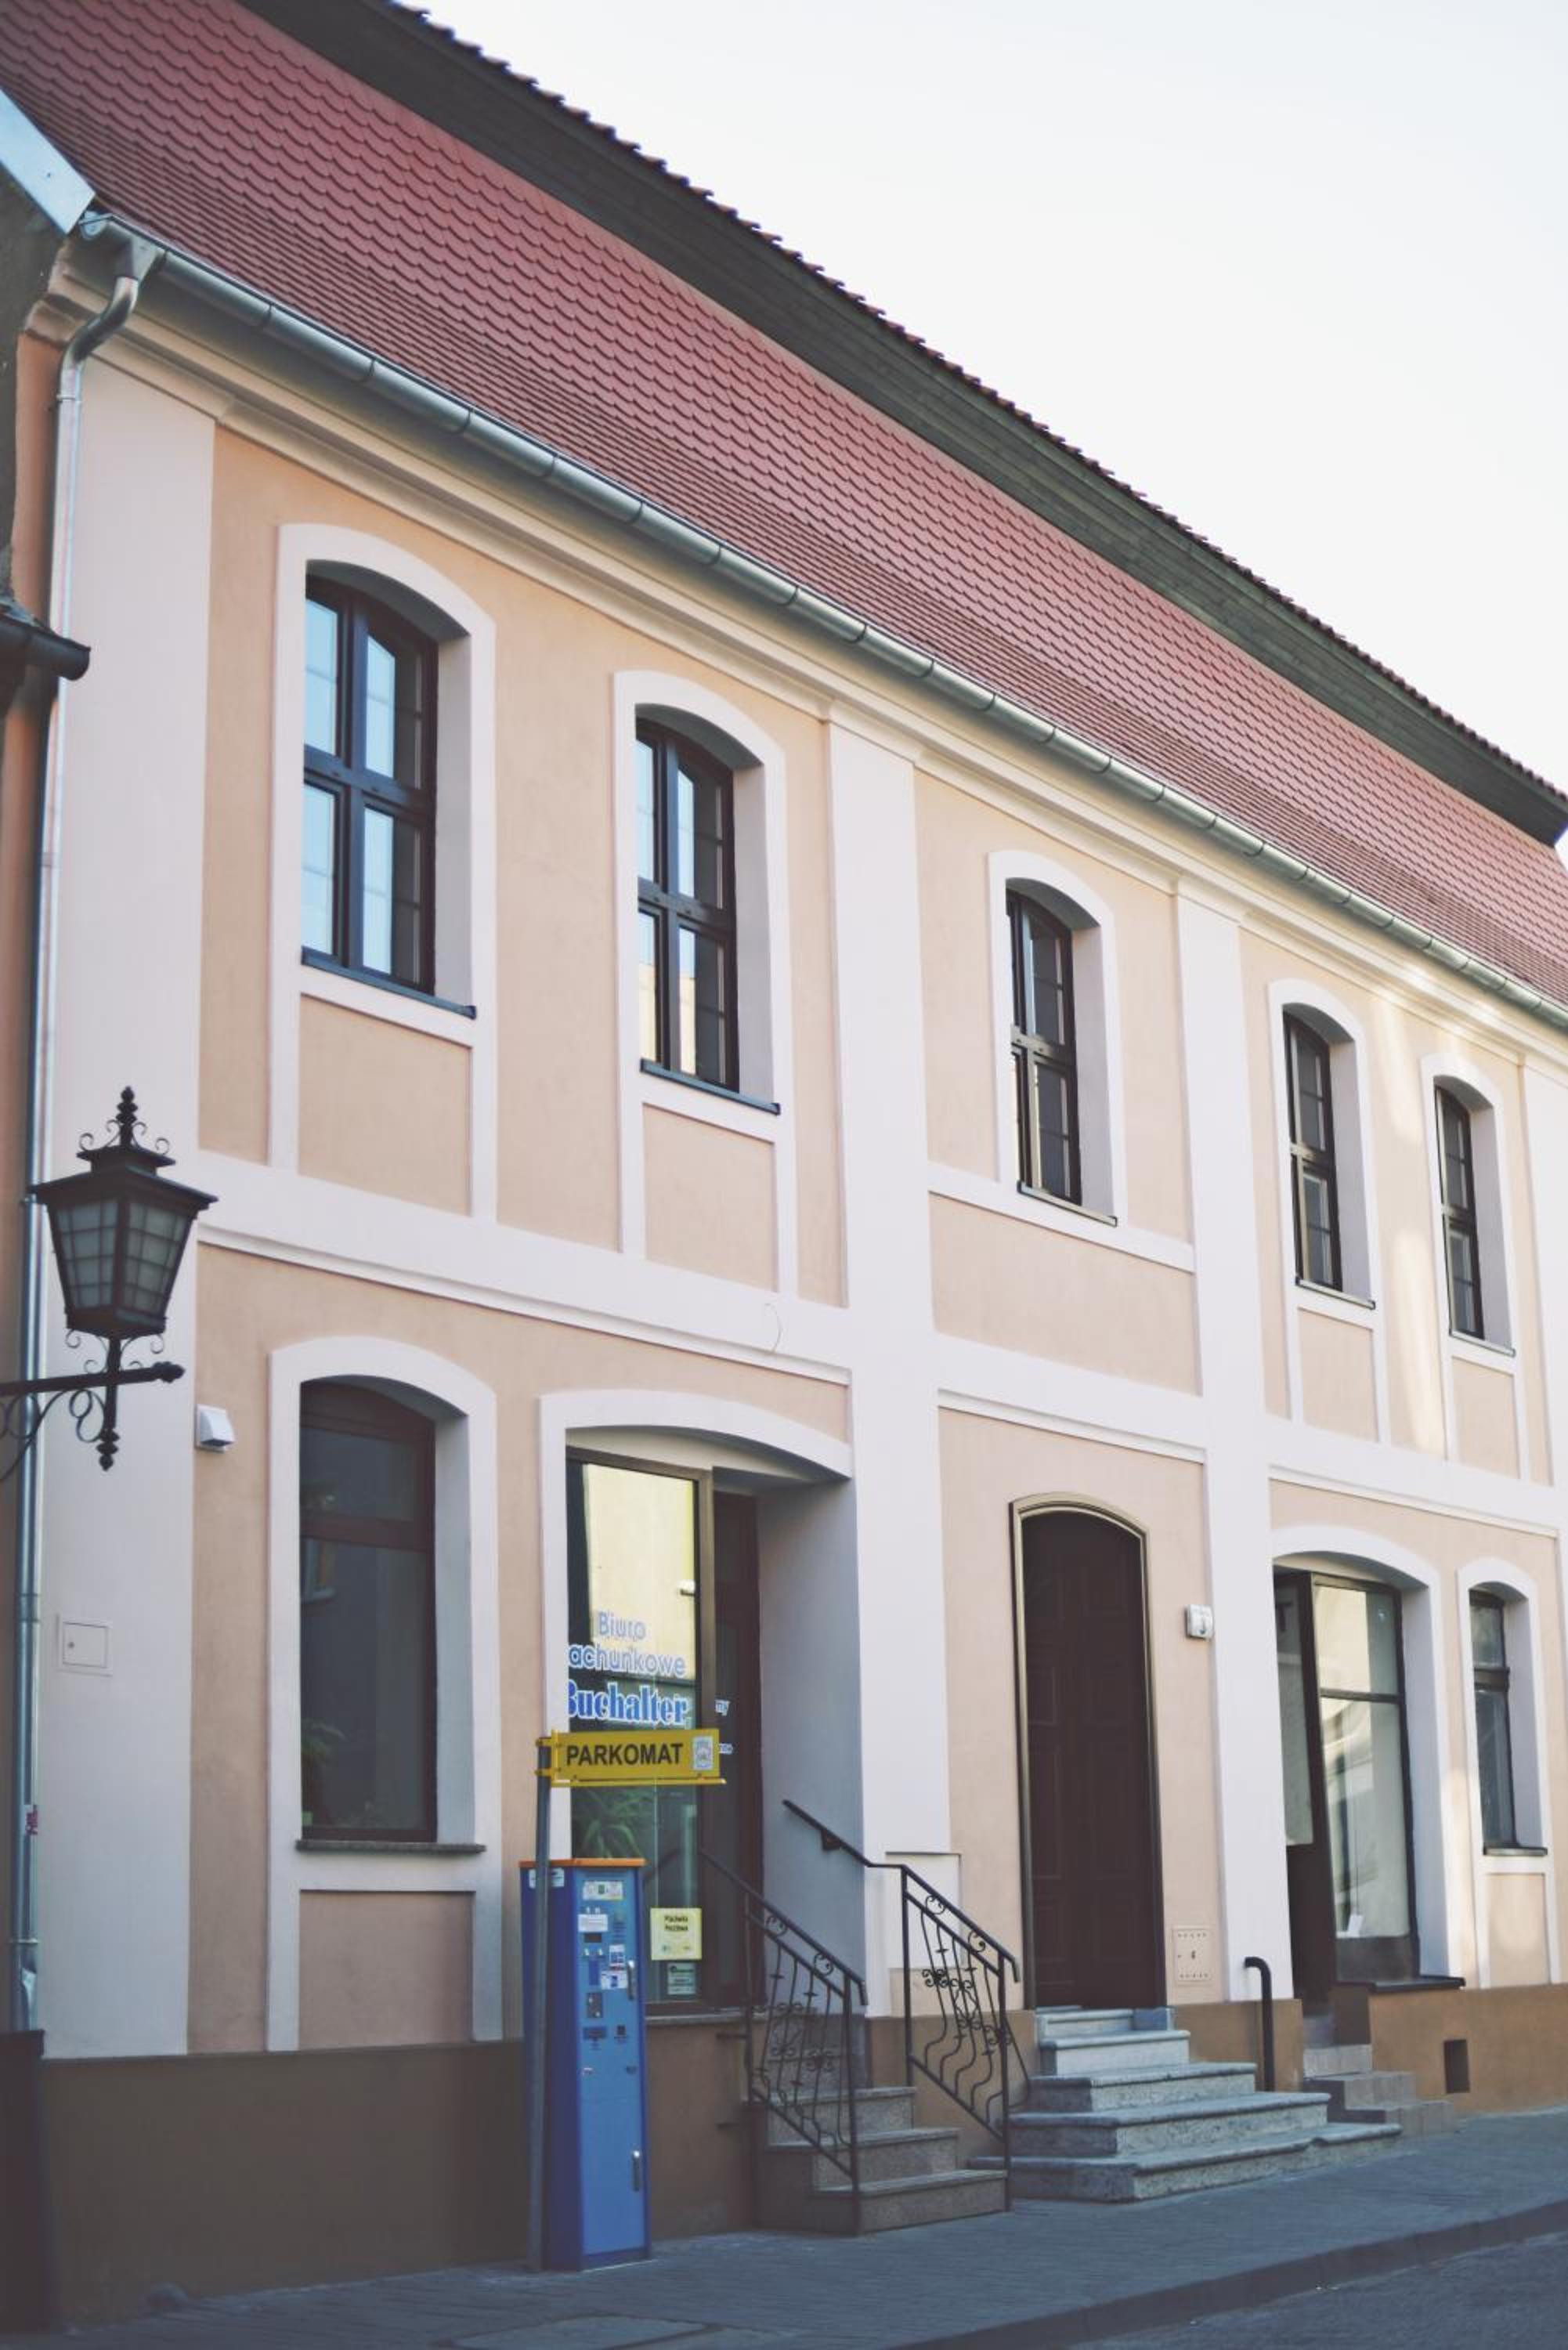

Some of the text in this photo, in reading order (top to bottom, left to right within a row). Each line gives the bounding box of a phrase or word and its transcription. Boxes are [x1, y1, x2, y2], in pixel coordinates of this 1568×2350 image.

[597, 1611, 646, 1640] Biuro
[569, 1643, 686, 1676] achunkowe
[566, 1744, 683, 1766] PARKOMAT
